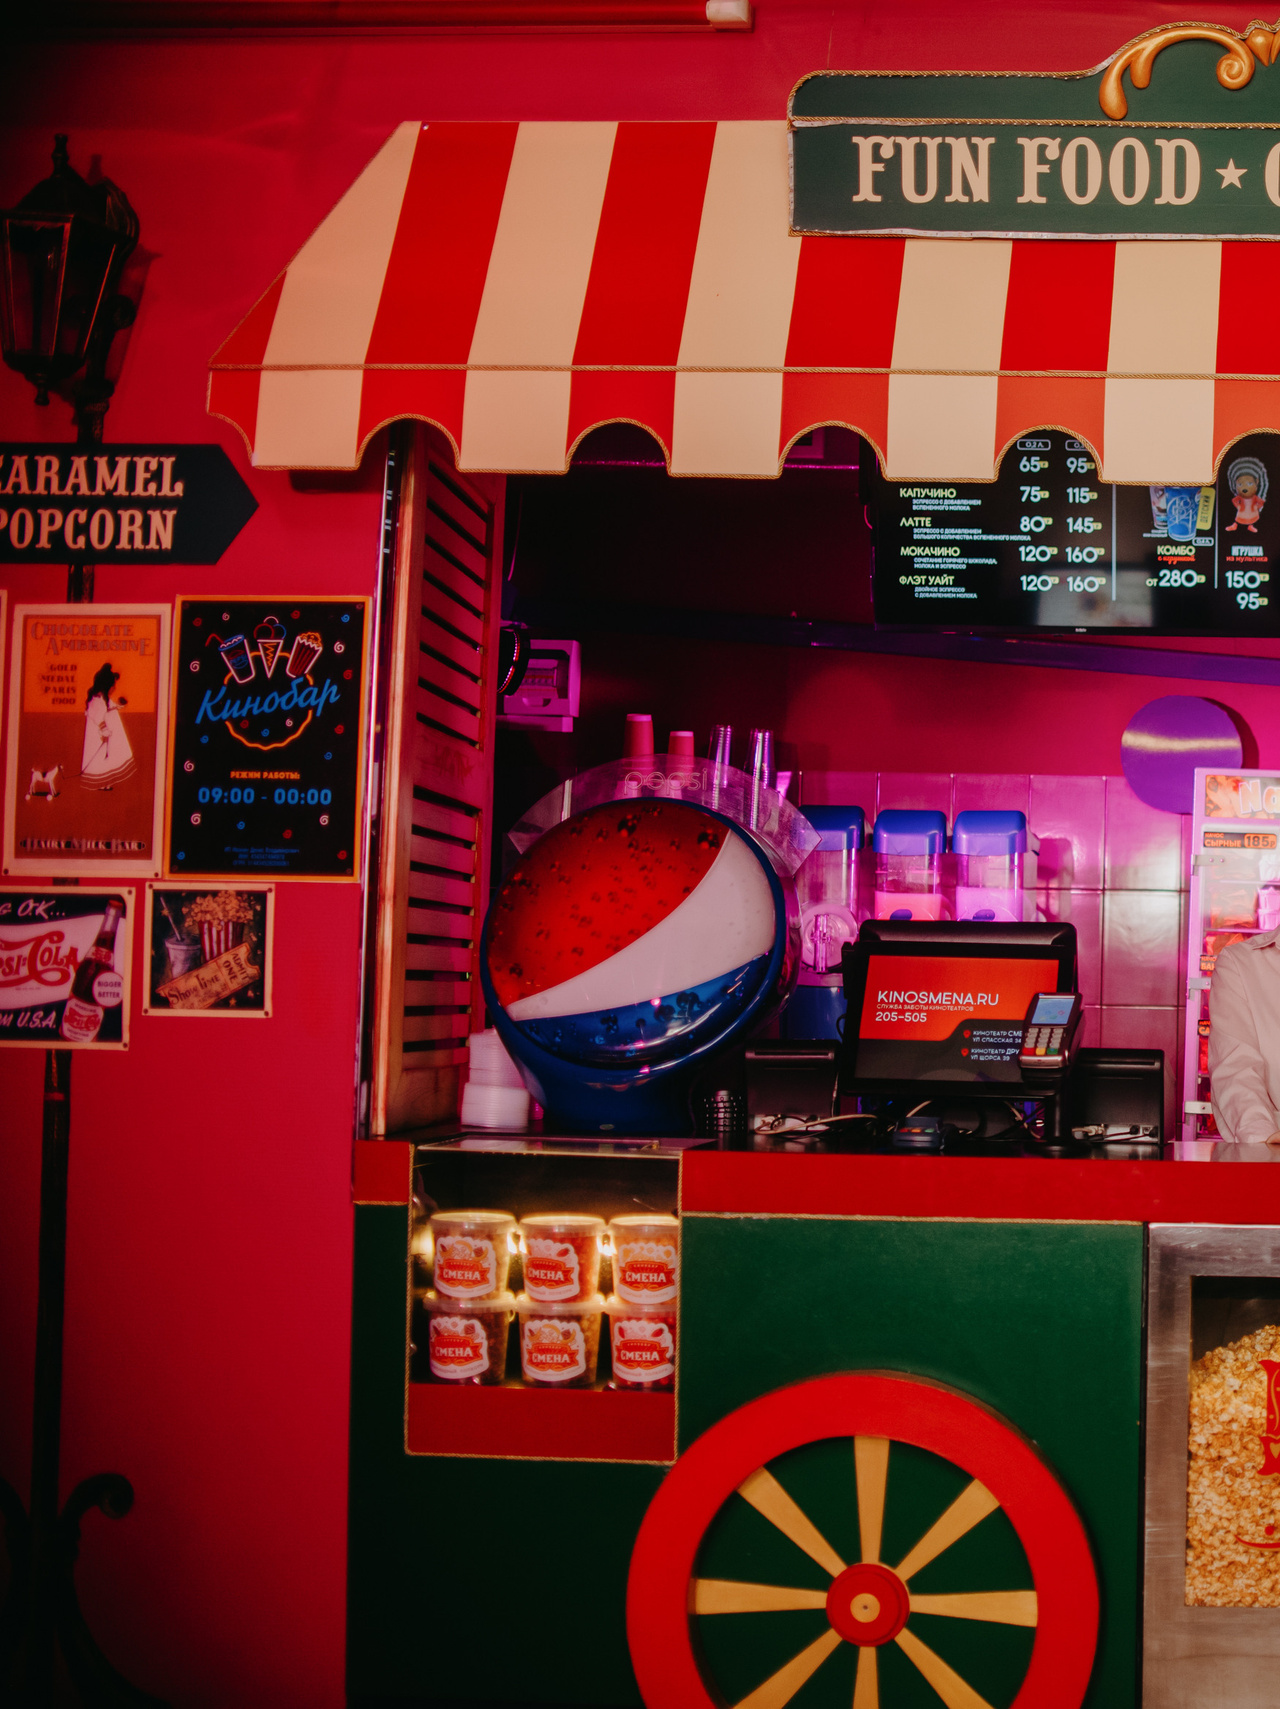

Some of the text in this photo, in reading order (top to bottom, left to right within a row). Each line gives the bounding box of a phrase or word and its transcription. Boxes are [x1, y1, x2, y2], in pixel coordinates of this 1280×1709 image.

[852, 136, 996, 204] FUN
[1016, 136, 1201, 206] FOOD
[1019, 456, 1041, 473] 65
[1066, 457, 1088, 474] 95
[899, 488, 957, 499] КАПУЧИНО
[1020, 486, 1042, 503] 75
[1066, 487, 1091, 504] 115
[900, 517, 932, 527] ЛАТТЕ
[1020, 516, 1046, 533] 80
[1066, 517, 1095, 534] 145
[900, 546, 960, 557] МОКАЧИНО
[1019, 545, 1052, 562] 120
[1065, 546, 1099, 563] 160
[1157, 545, 1196, 556] КОМБО
[1231, 545, 1263, 557] ИГРУШКА
[899, 574, 955, 585] ФЛЭТ УАЙТ
[1020, 575, 1053, 592] 120
[1066, 576, 1100, 593] 160
[1159, 569, 1198, 587] 280
[1225, 570, 1261, 588] 150
[1236, 592, 1261, 610] 95
[44, 686, 76, 694] PARIS
[195, 676, 341, 724] Кинобар
[230, 770, 261, 779] РЕЖИМ
[624, 768, 707, 796] pepsi
[198, 787, 332, 805] 09:00 00:00
[1204, 839, 1241, 848] СЫРНЫЕ
[223, 960, 238, 982] ONE
[877, 990, 999, 1006] KINOSMENA.RU
[875, 1012, 927, 1022] 205-505
[442, 1270, 481, 1281] СМЕНА
[528, 1270, 564, 1282] СМЕНА
[625, 1272, 666, 1283] СМЕНА
[435, 1347, 473, 1357] СМЕНА
[531, 1353, 570, 1364] СМЕНА
[620, 1350, 660, 1361] СМЕНА
